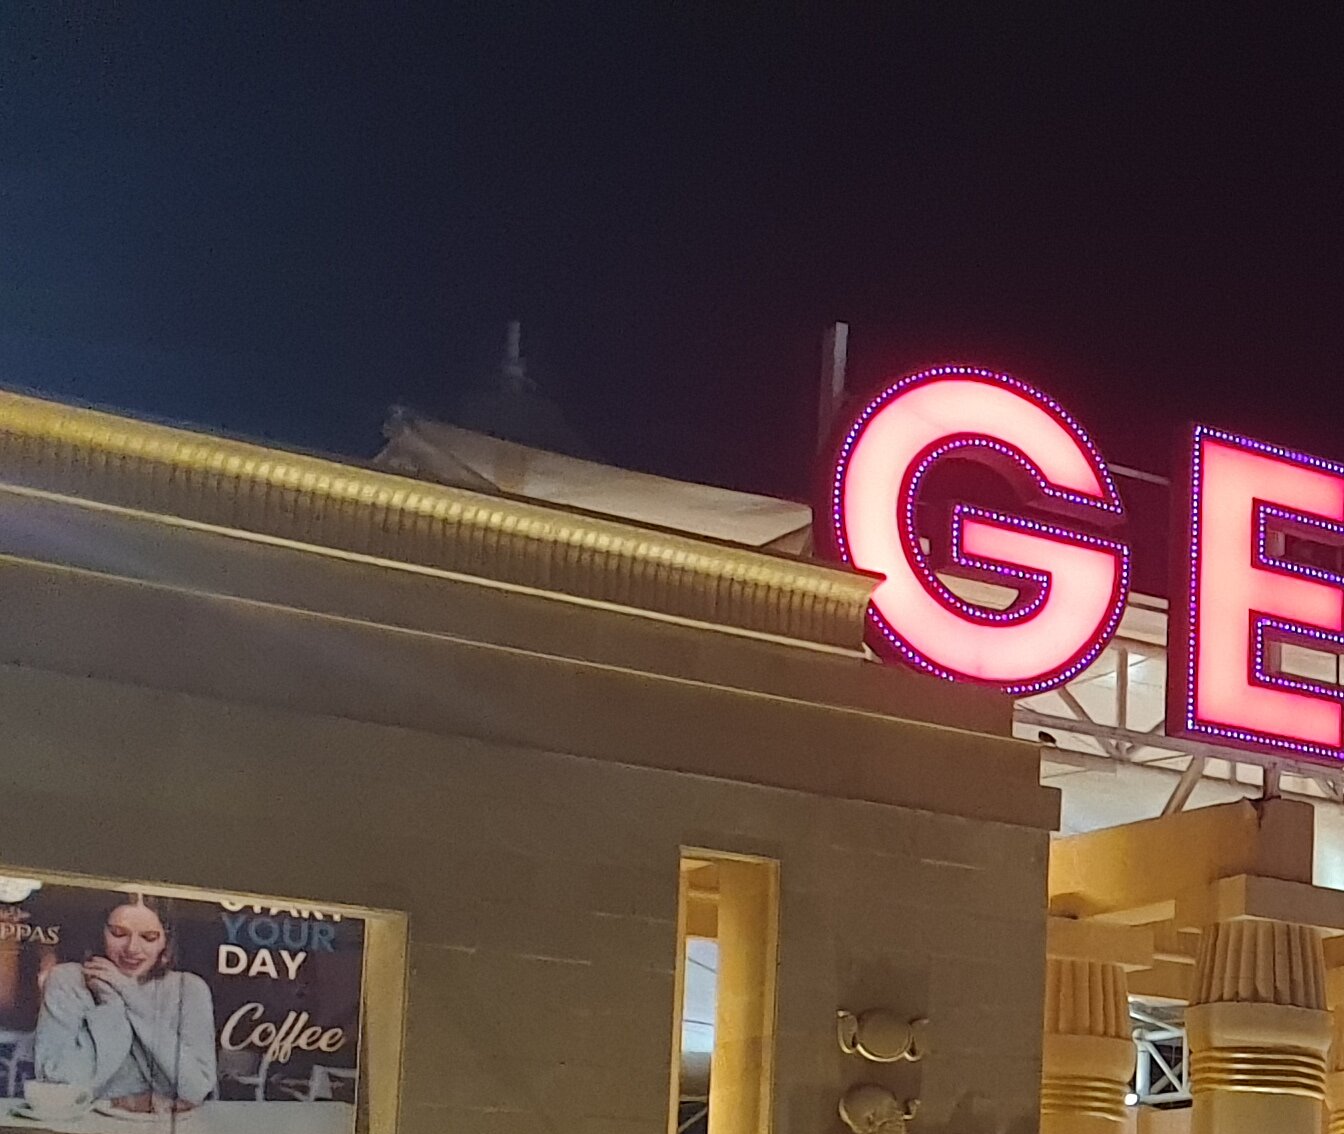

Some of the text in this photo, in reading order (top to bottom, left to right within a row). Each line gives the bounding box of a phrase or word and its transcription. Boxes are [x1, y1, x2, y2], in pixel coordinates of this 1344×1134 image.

[221, 911, 337, 953] YOUR
[218, 944, 308, 980] DAY
[219, 1002, 346, 1064] Coffee
